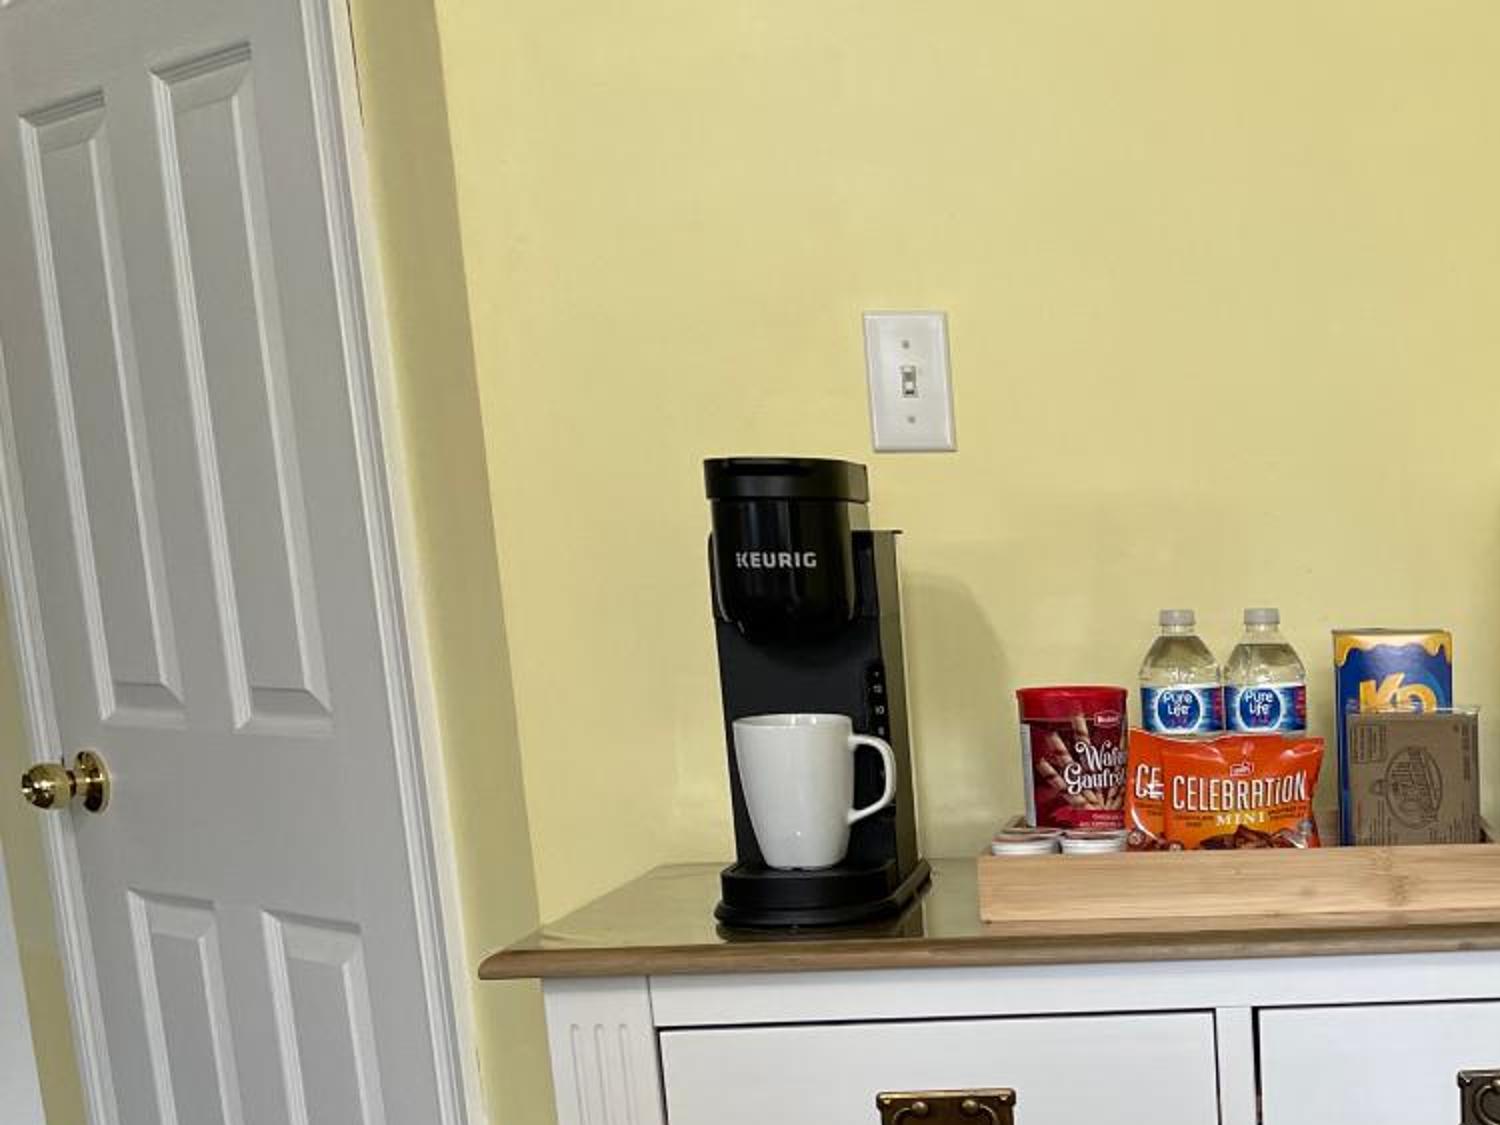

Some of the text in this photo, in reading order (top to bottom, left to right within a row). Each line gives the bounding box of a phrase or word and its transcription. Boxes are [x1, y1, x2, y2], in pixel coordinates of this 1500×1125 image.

[735, 552, 817, 568] KEURIG
[1163, 691, 1193, 703] Pure
[1245, 691, 1273, 703] Pure
[1168, 704, 1191, 717] Life
[1249, 704, 1270, 717] Life
[1172, 769, 1308, 811] CELEBRATION
[1216, 811, 1265, 827] MINI
